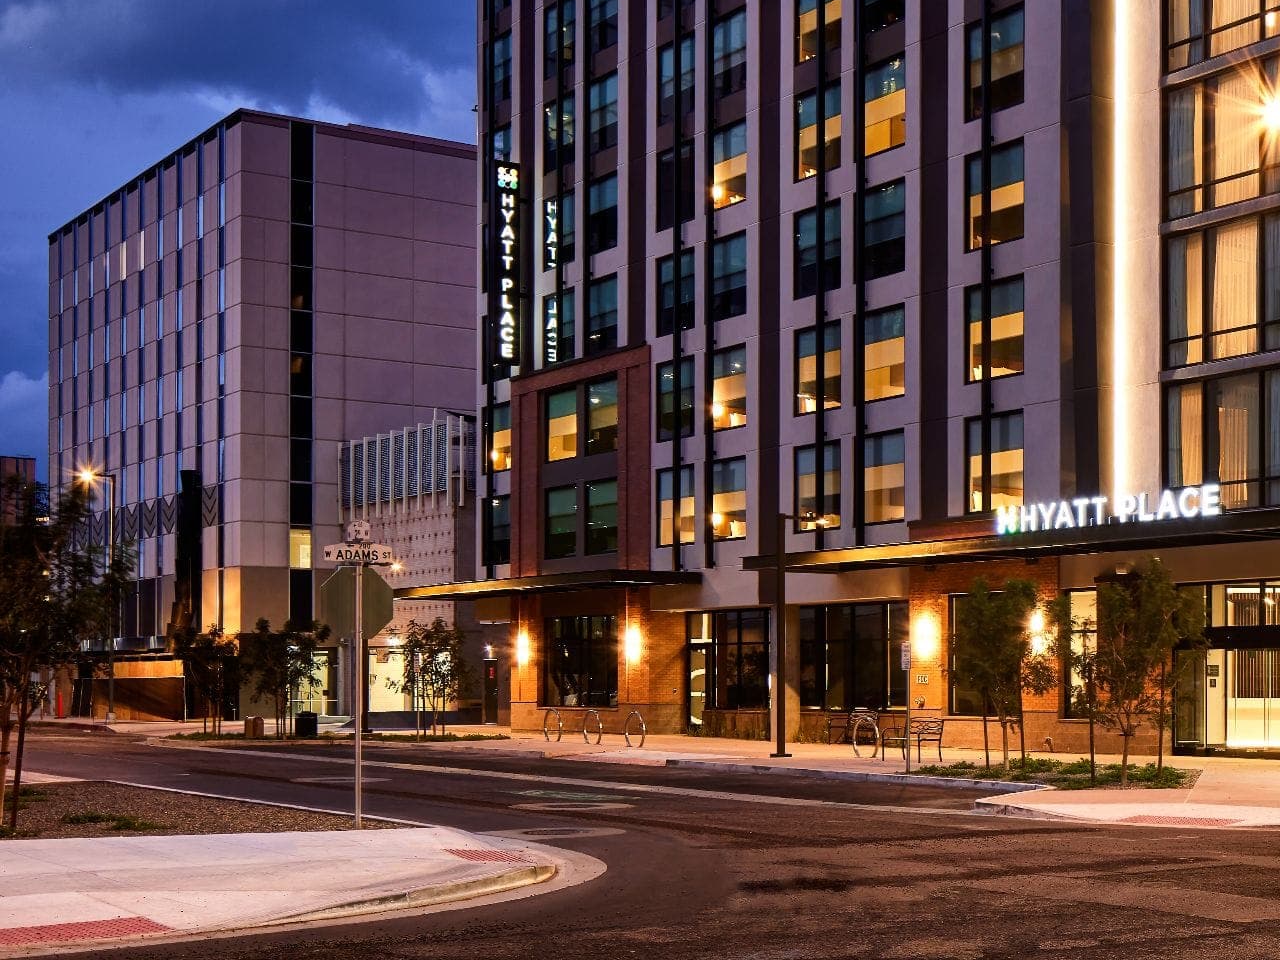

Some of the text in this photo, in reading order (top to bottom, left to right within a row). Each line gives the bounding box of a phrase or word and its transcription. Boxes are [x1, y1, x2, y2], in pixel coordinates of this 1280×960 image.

[501, 193, 515, 359] HYATT PLACE
[1020, 484, 1223, 533] HYATT PLACE
[325, 549, 391, 561] W ADAMS ST
